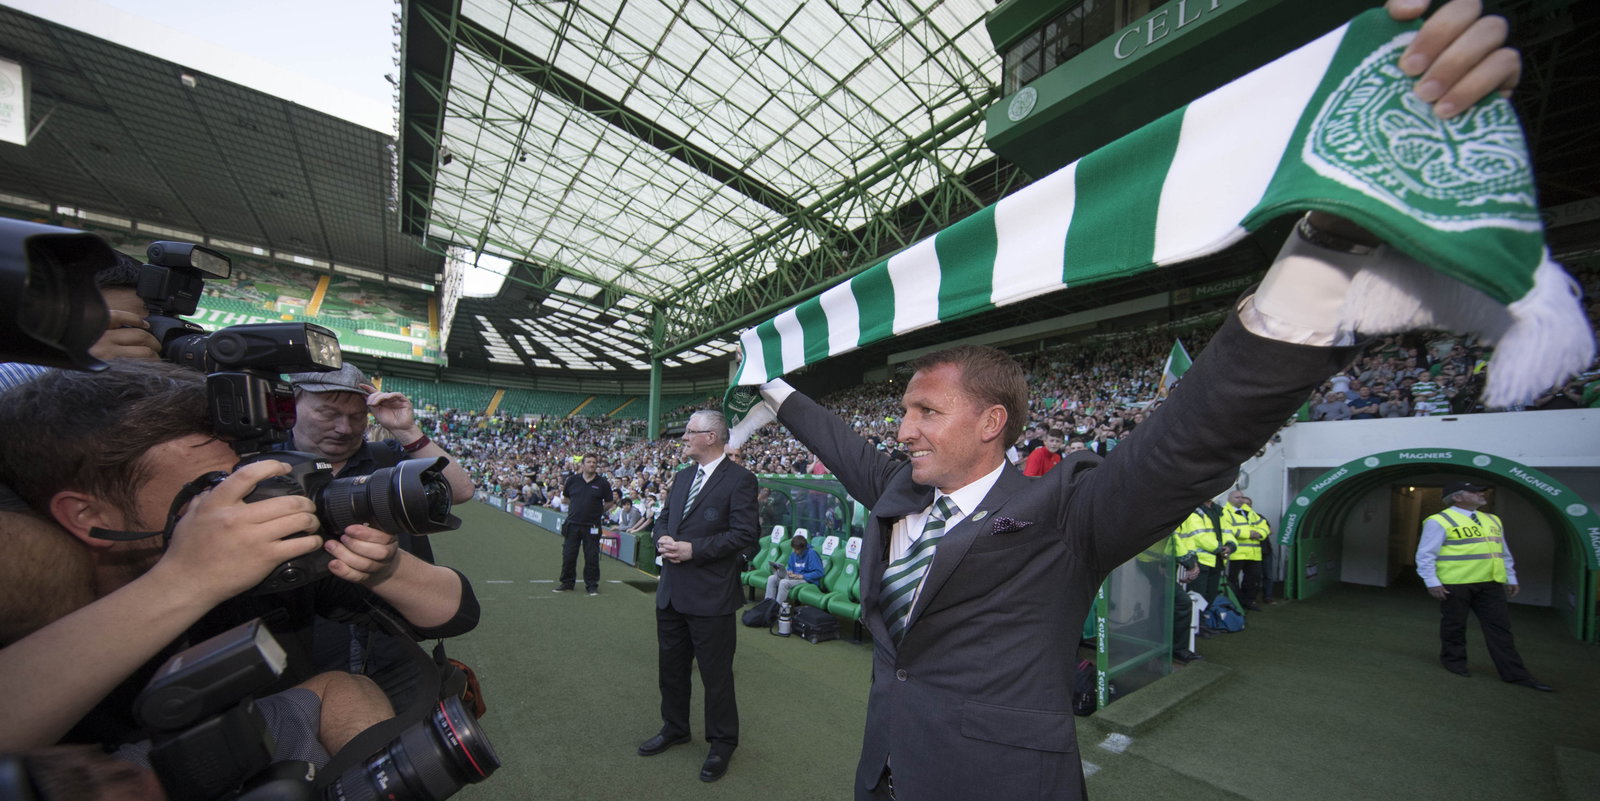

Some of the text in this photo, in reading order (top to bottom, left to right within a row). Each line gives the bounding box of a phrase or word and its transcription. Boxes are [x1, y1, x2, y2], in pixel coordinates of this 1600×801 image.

[1196, 276, 1252, 296] MAGNERS
[316, 462, 333, 470] Nikon
[1311, 467, 1348, 492] MAGNERS
[1509, 466, 1562, 496] MAGNERS
[1282, 513, 1297, 543] MAGNERS
[1452, 526, 1482, 539] 108
